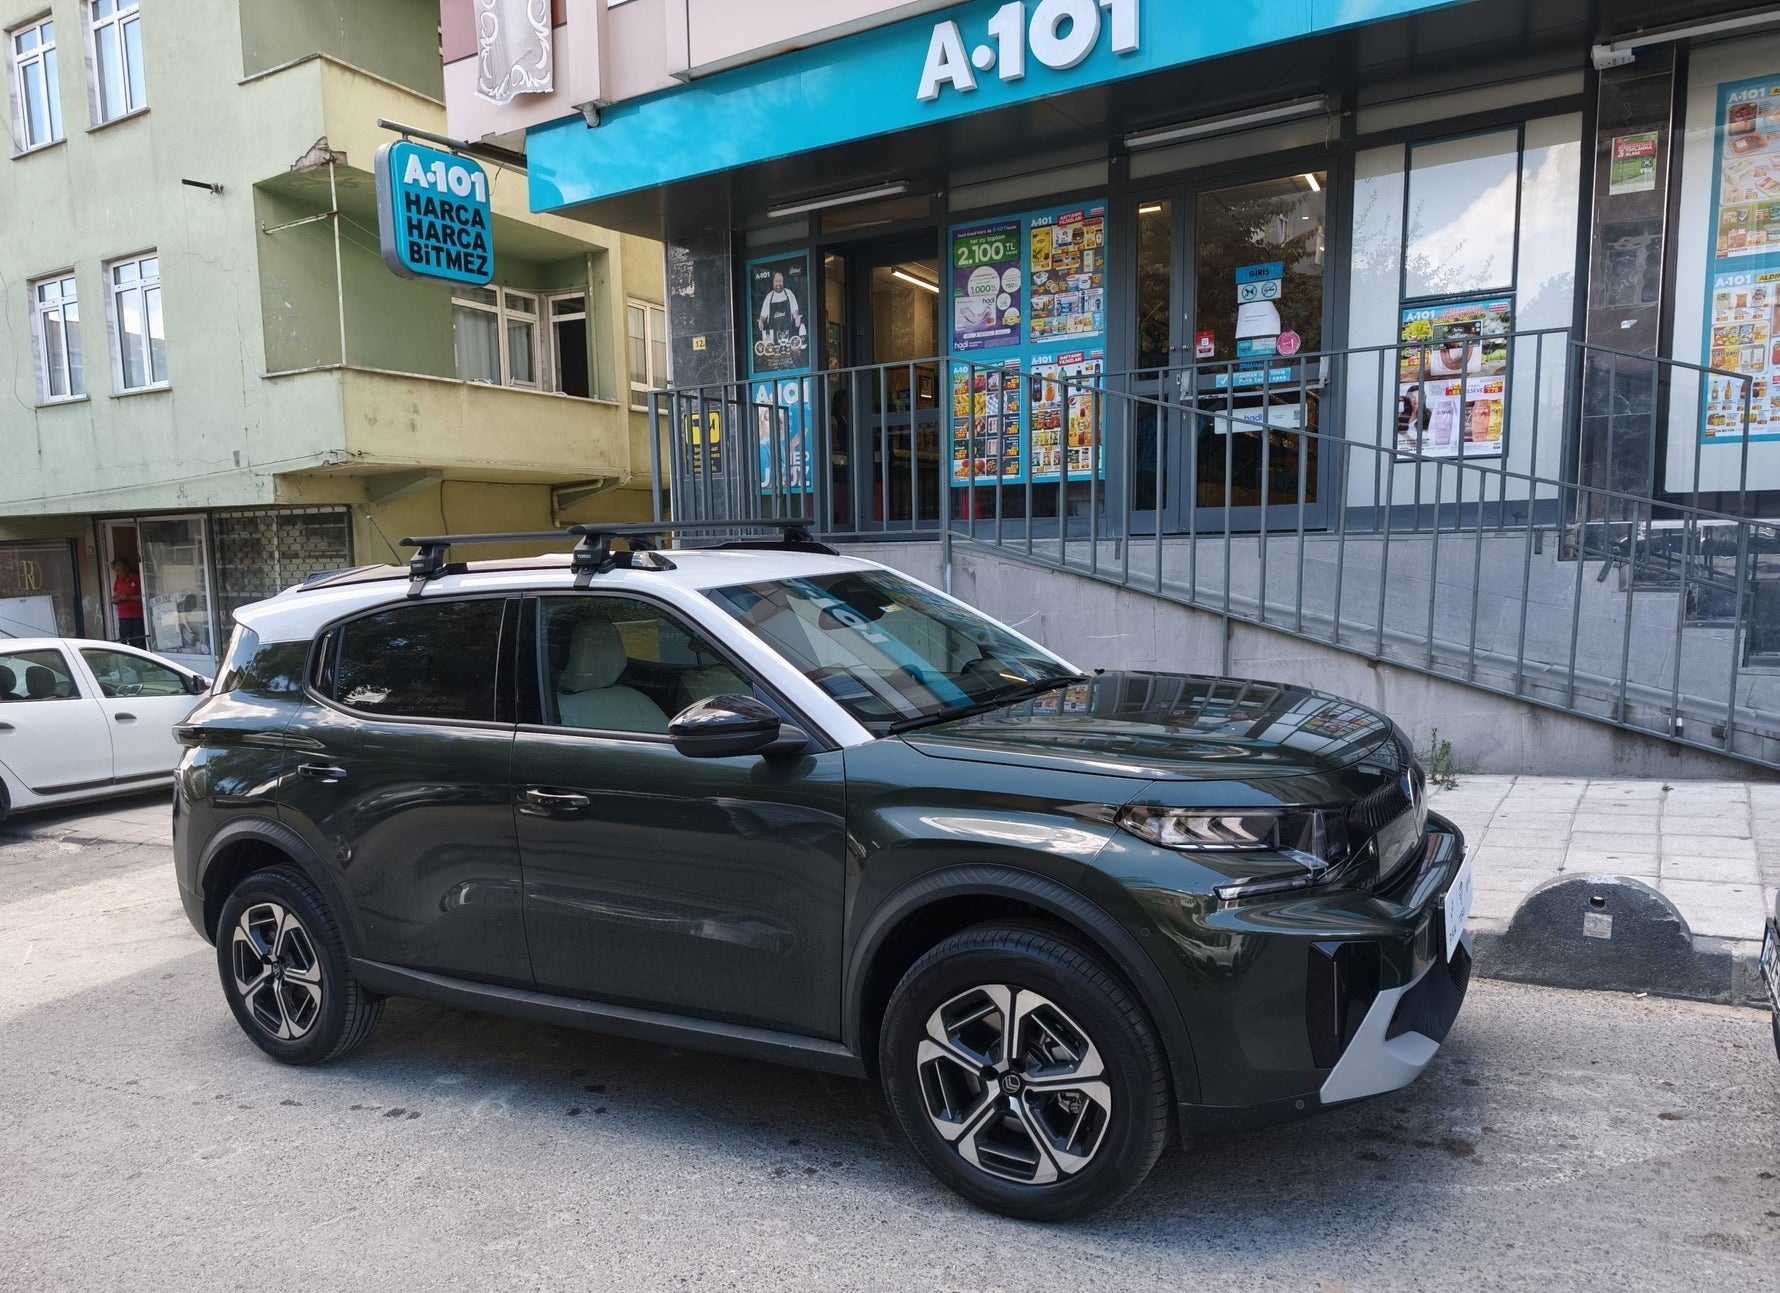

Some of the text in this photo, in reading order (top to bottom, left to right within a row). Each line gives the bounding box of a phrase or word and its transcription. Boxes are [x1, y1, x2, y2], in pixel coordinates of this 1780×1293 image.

[405, 191, 487, 230] HARCA
[407, 216, 488, 253] HARCA
[957, 242, 1016, 265] 2.100 TL
